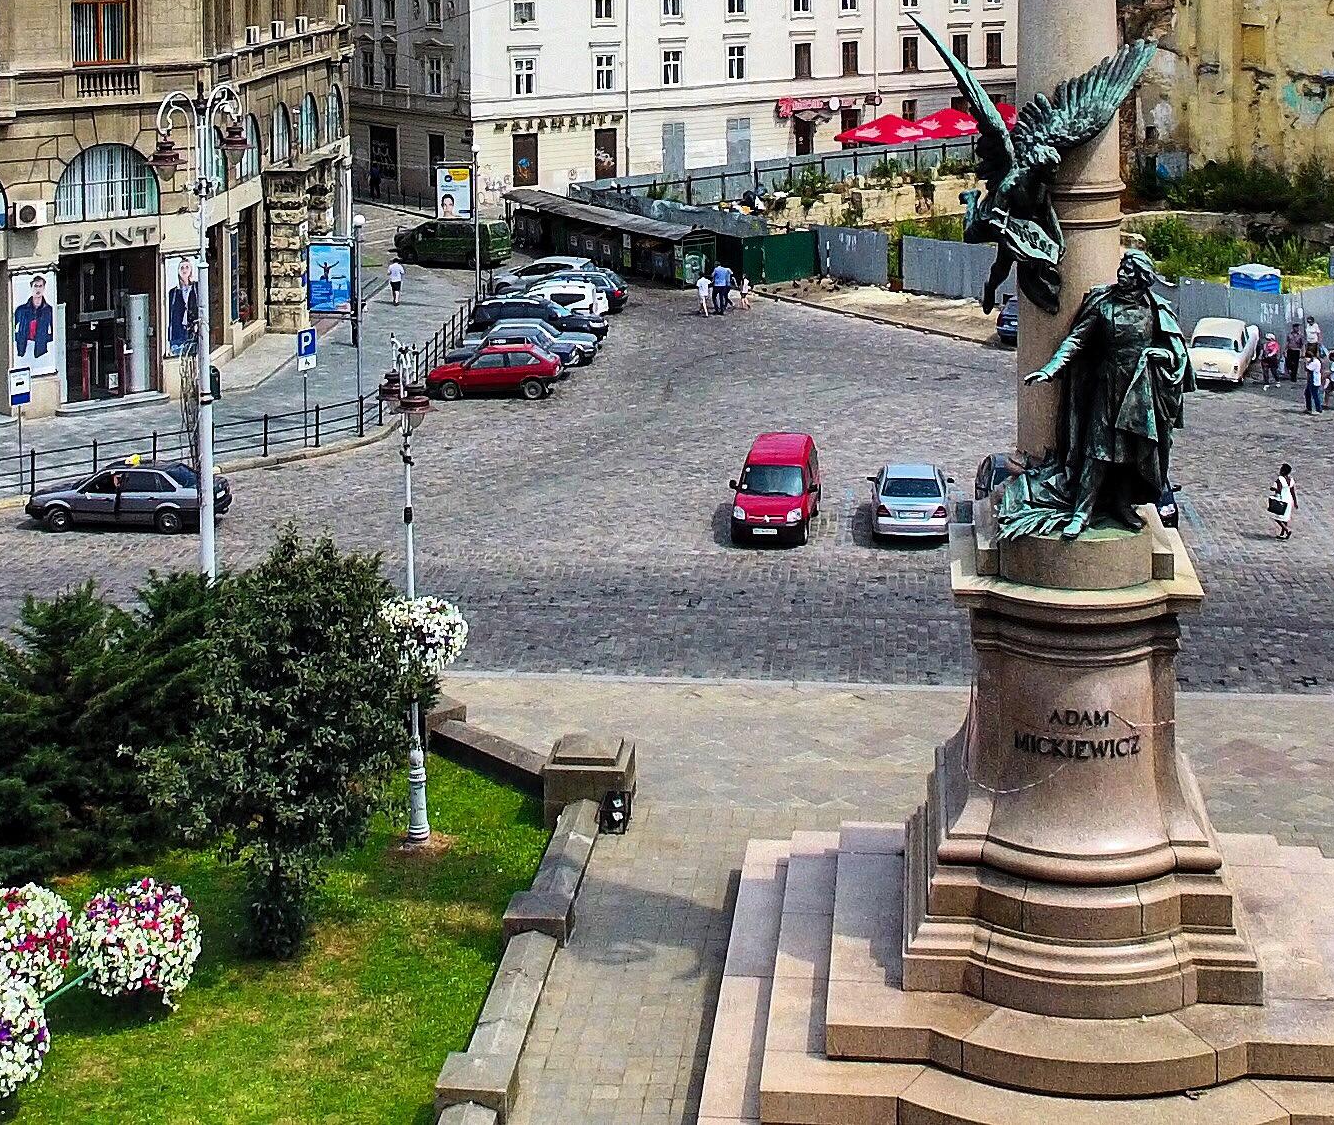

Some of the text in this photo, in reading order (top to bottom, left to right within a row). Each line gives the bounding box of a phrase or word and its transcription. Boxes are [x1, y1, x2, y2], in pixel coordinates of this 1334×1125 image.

[59, 225, 157, 252] GANT
[301, 332, 312, 355] P
[1048, 709, 1110, 727] ADAM
[1014, 732, 1140, 759] MICKIEWICZ
